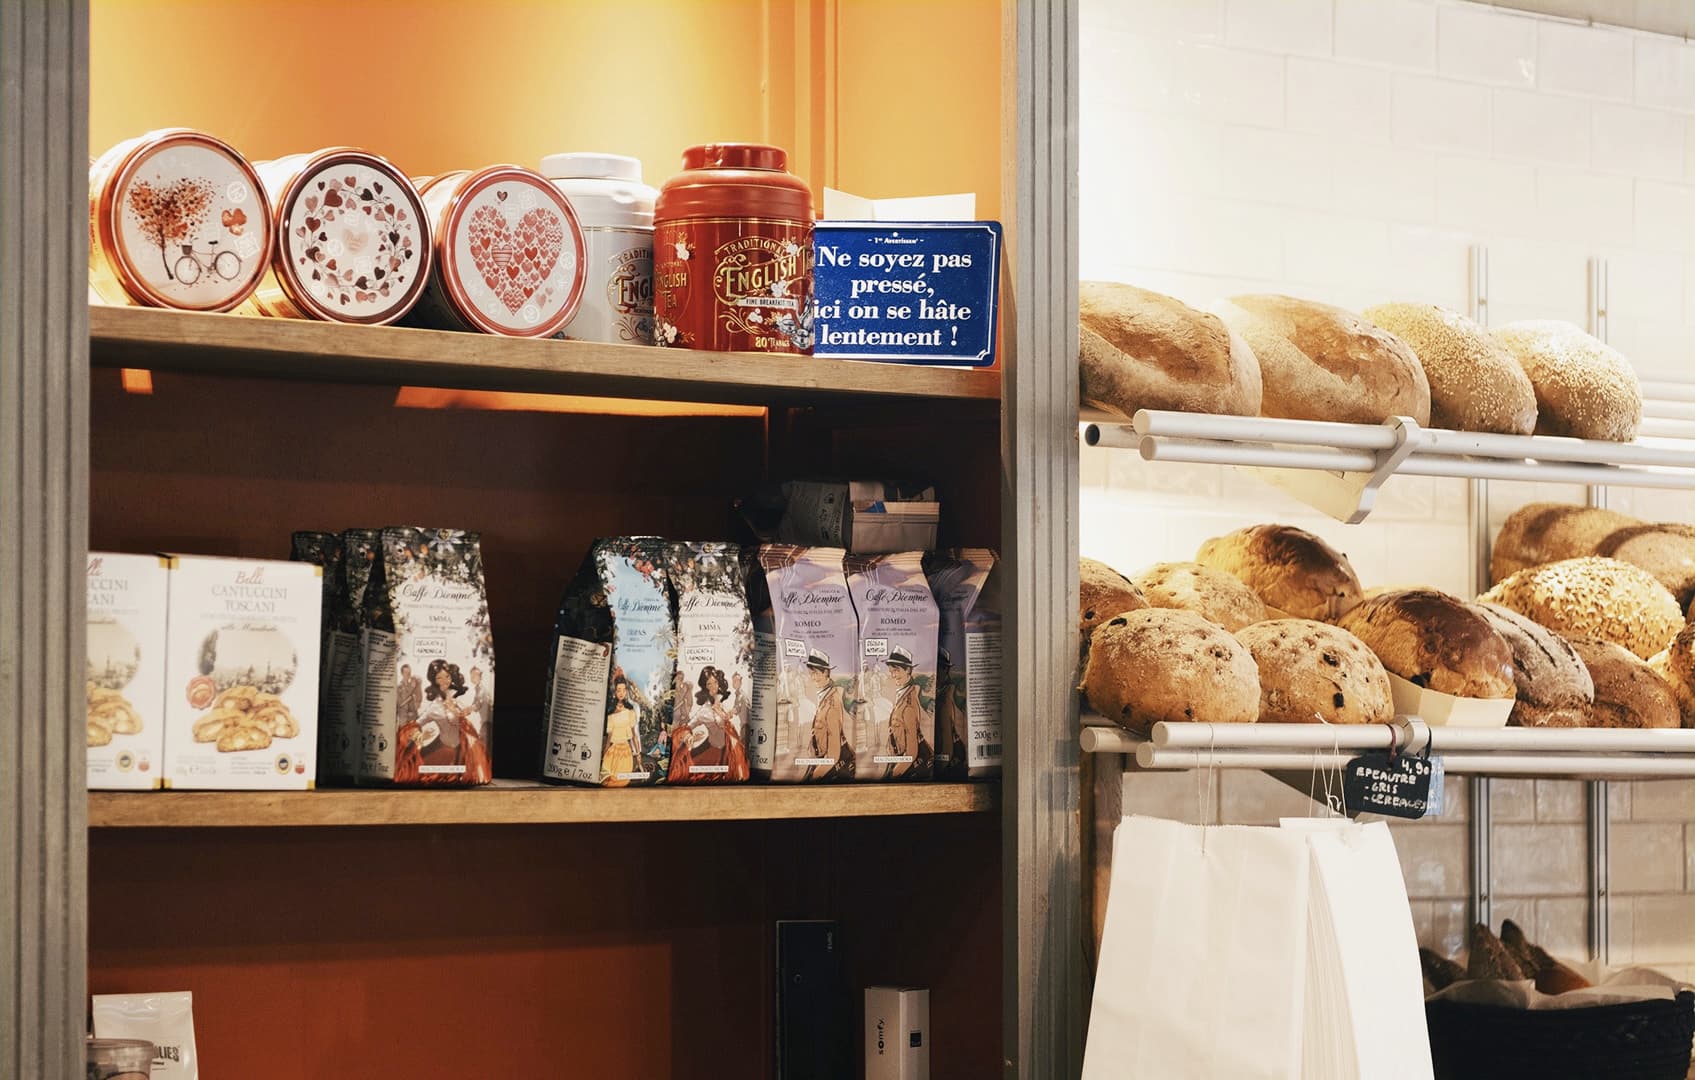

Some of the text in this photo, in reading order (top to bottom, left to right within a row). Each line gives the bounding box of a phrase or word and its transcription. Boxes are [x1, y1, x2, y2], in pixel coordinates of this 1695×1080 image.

[617, 249, 652, 265] TRADITI
[817, 246, 851, 267] Ne
[858, 253, 925, 273] soyez
[932, 253, 972, 273] pas
[720, 254, 796, 299] ENGLISH
[851, 272, 935, 299] pressé,
[614, 271, 653, 309] ENGL
[814, 299, 971, 320] ici on se hâte
[820, 324, 942, 346] lentement
[211, 584, 288, 600] CANTUCCINI
[224, 599, 275, 613] TOSCANI
[881, 617, 906, 625] ROMEO
[974, 731, 991, 742] 200g
[1356, 766, 1416, 785] EPEAUTRE
[1371, 782, 1398, 795] GRIS
[877, 1018, 885, 1056] somfy
